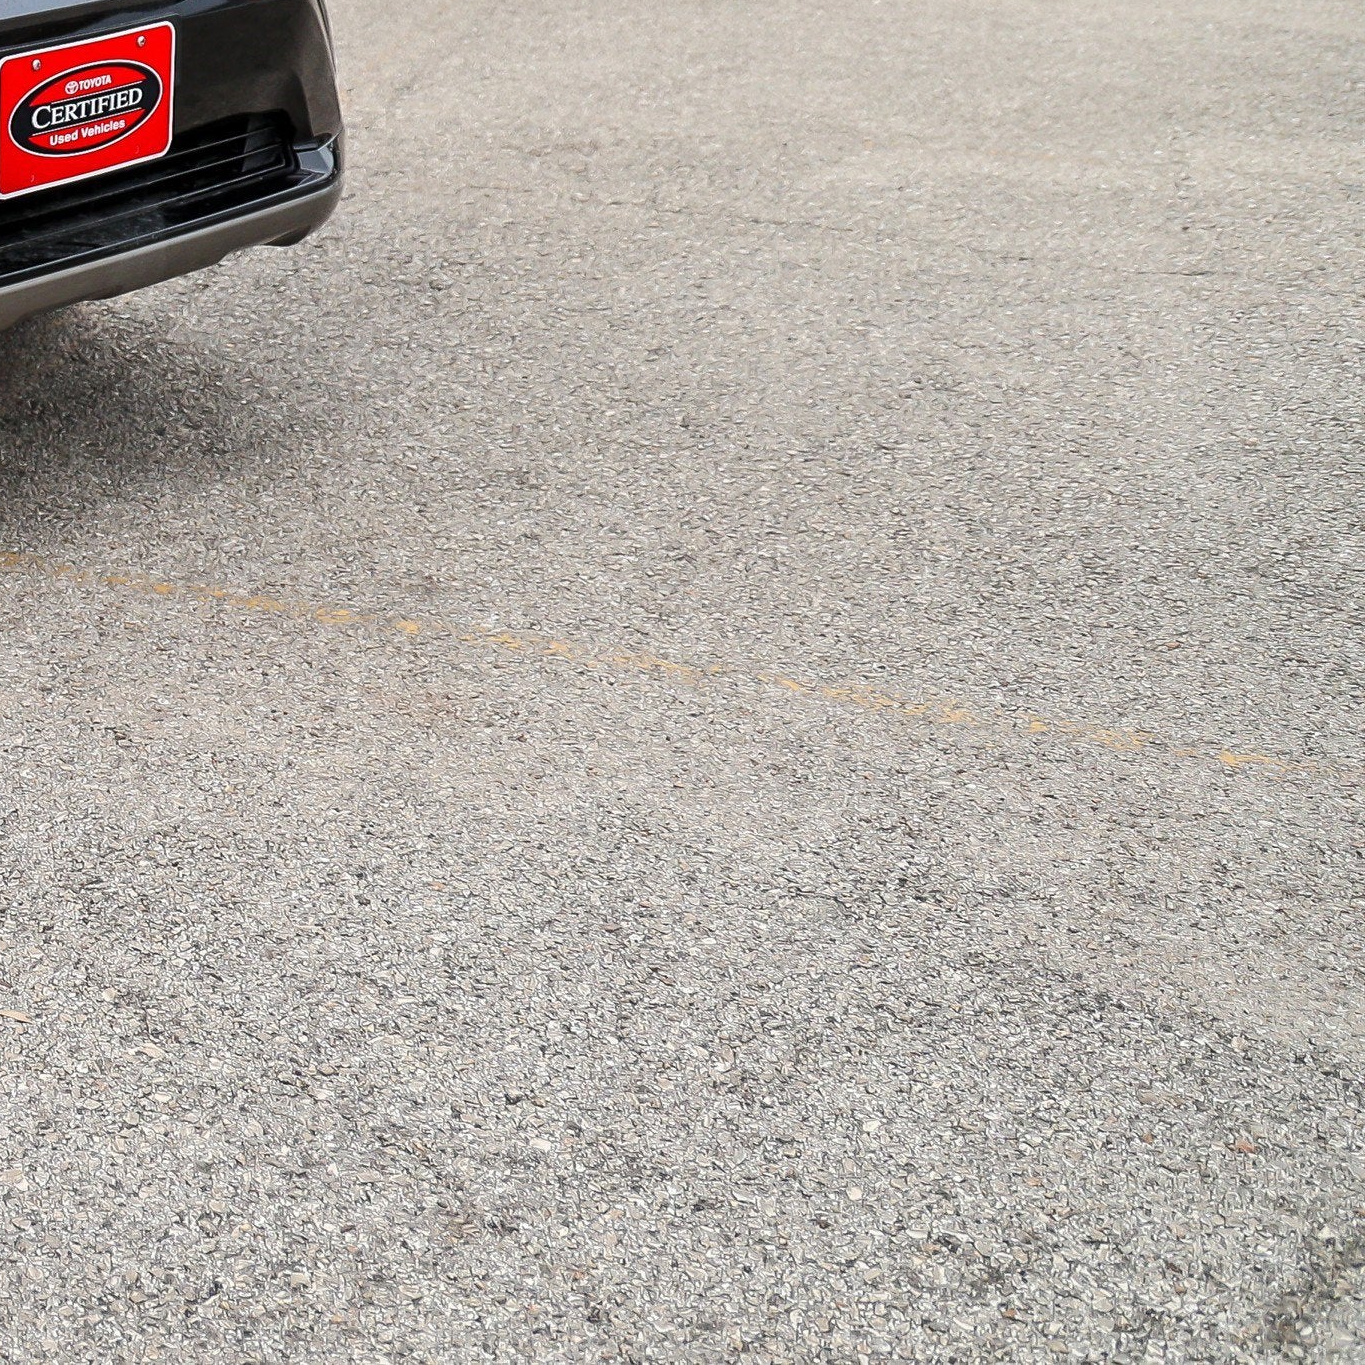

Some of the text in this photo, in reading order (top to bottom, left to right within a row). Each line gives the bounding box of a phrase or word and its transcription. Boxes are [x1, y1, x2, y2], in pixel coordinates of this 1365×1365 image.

[78, 74, 112, 91] TOYOTA
[31, 87, 143, 130] CERTIFIED
[49, 118, 126, 146] Used Vehicles
